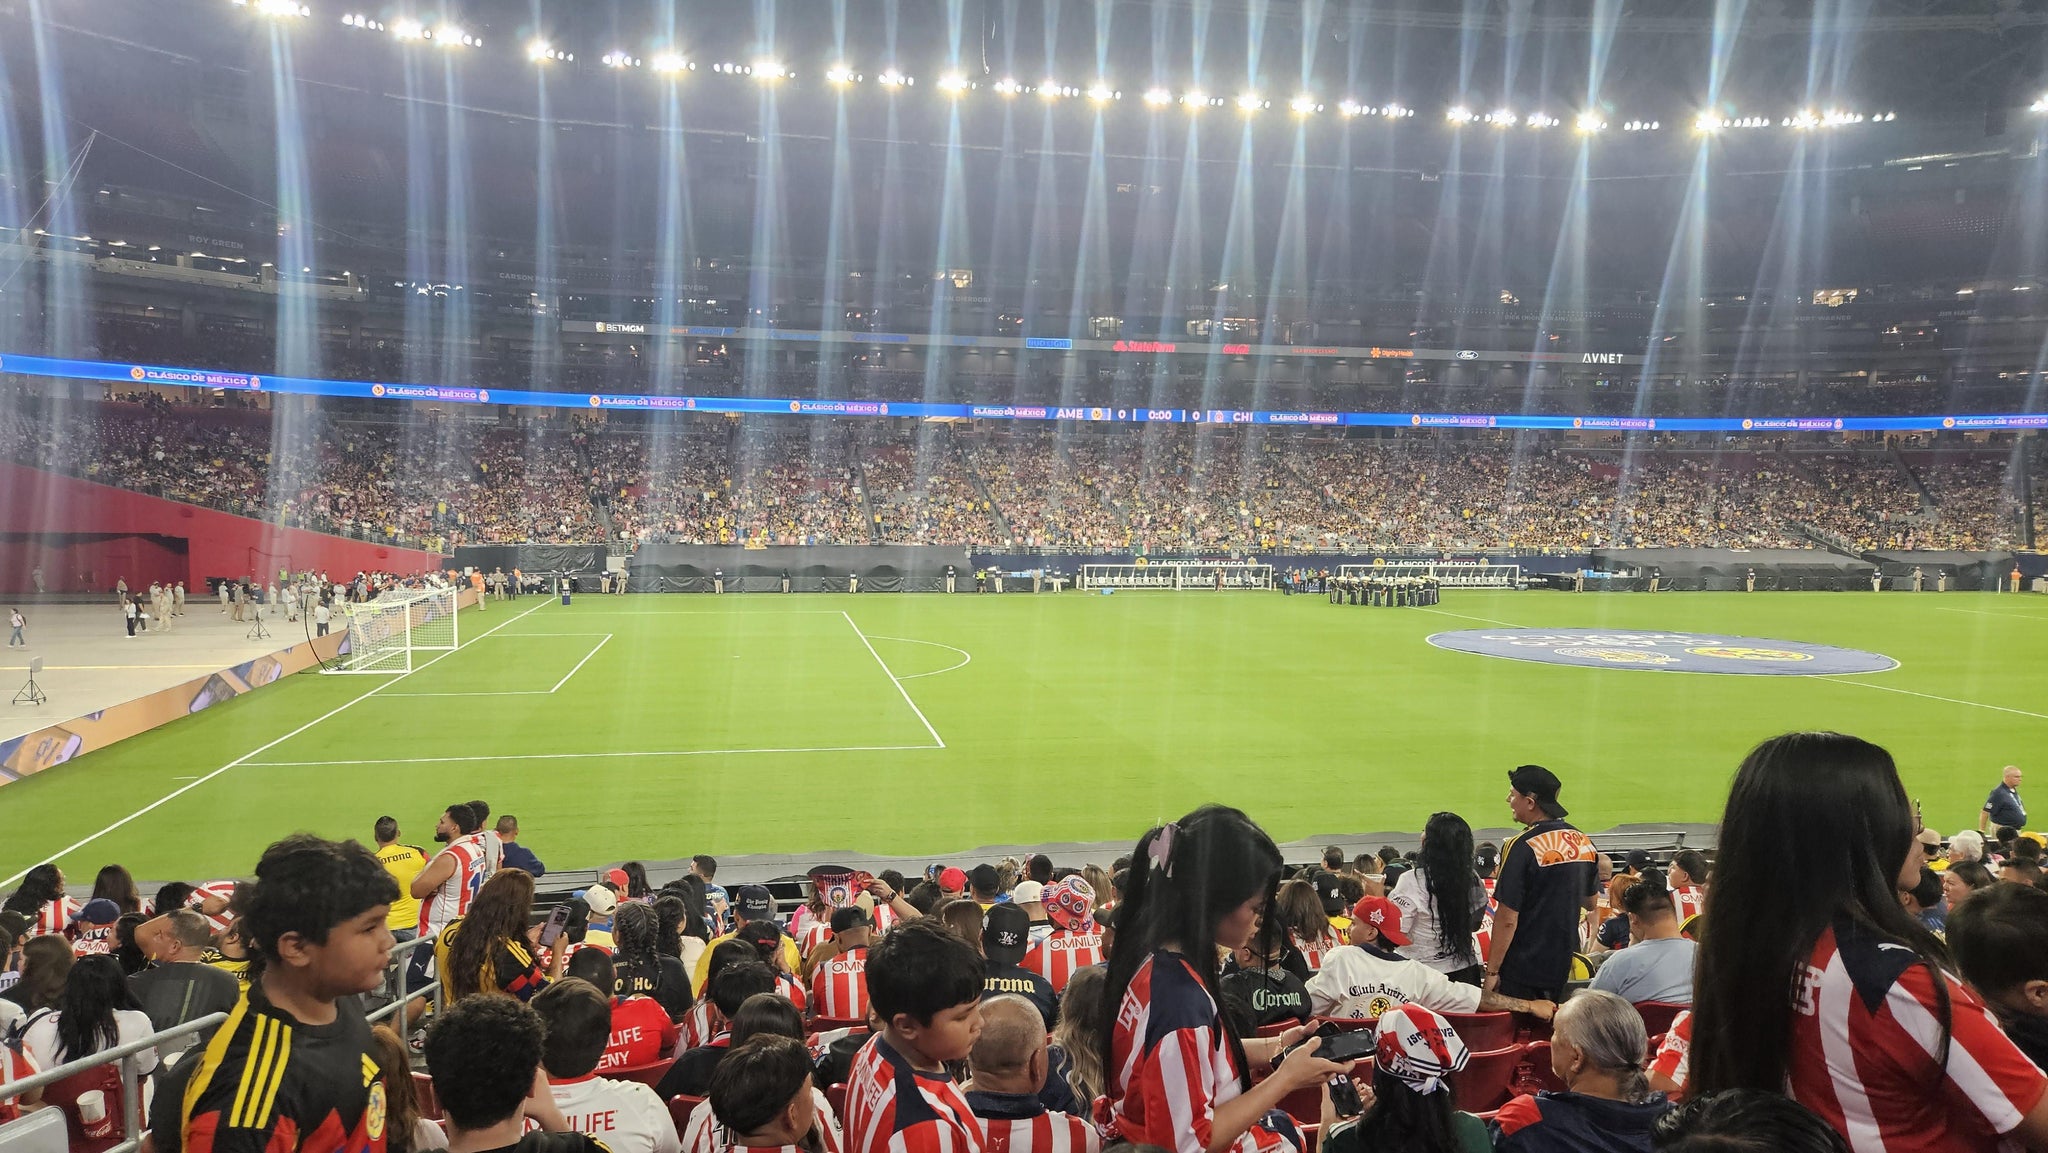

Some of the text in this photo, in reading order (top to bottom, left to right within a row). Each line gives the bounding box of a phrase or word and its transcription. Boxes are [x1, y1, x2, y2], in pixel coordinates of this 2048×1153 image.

[189, 235, 244, 249] ROY GREEN
[499, 272, 533, 282] CARSON
[606, 323, 644, 333] BETMGM
[1582, 353, 1624, 364] AVNET
[147, 370, 248, 385] CLÁSICO DE MÉXICO
[386, 386, 477, 399] CLÁSICO DE MÉXICO
[637, 398, 649, 406] DE
[834, 404, 845, 412] DE
[1056, 408, 1083, 419] AME
[1117, 409, 1126, 419] 0
[1148, 410, 1172, 420] 0:00
[1192, 410, 1200, 420] 0
[1232, 411, 1253, 422] CHI
[2008, 417, 2048, 425] MÉXICO
[1349, 983, 1375, 997] Club
[1252, 988, 1302, 1011] Corona
